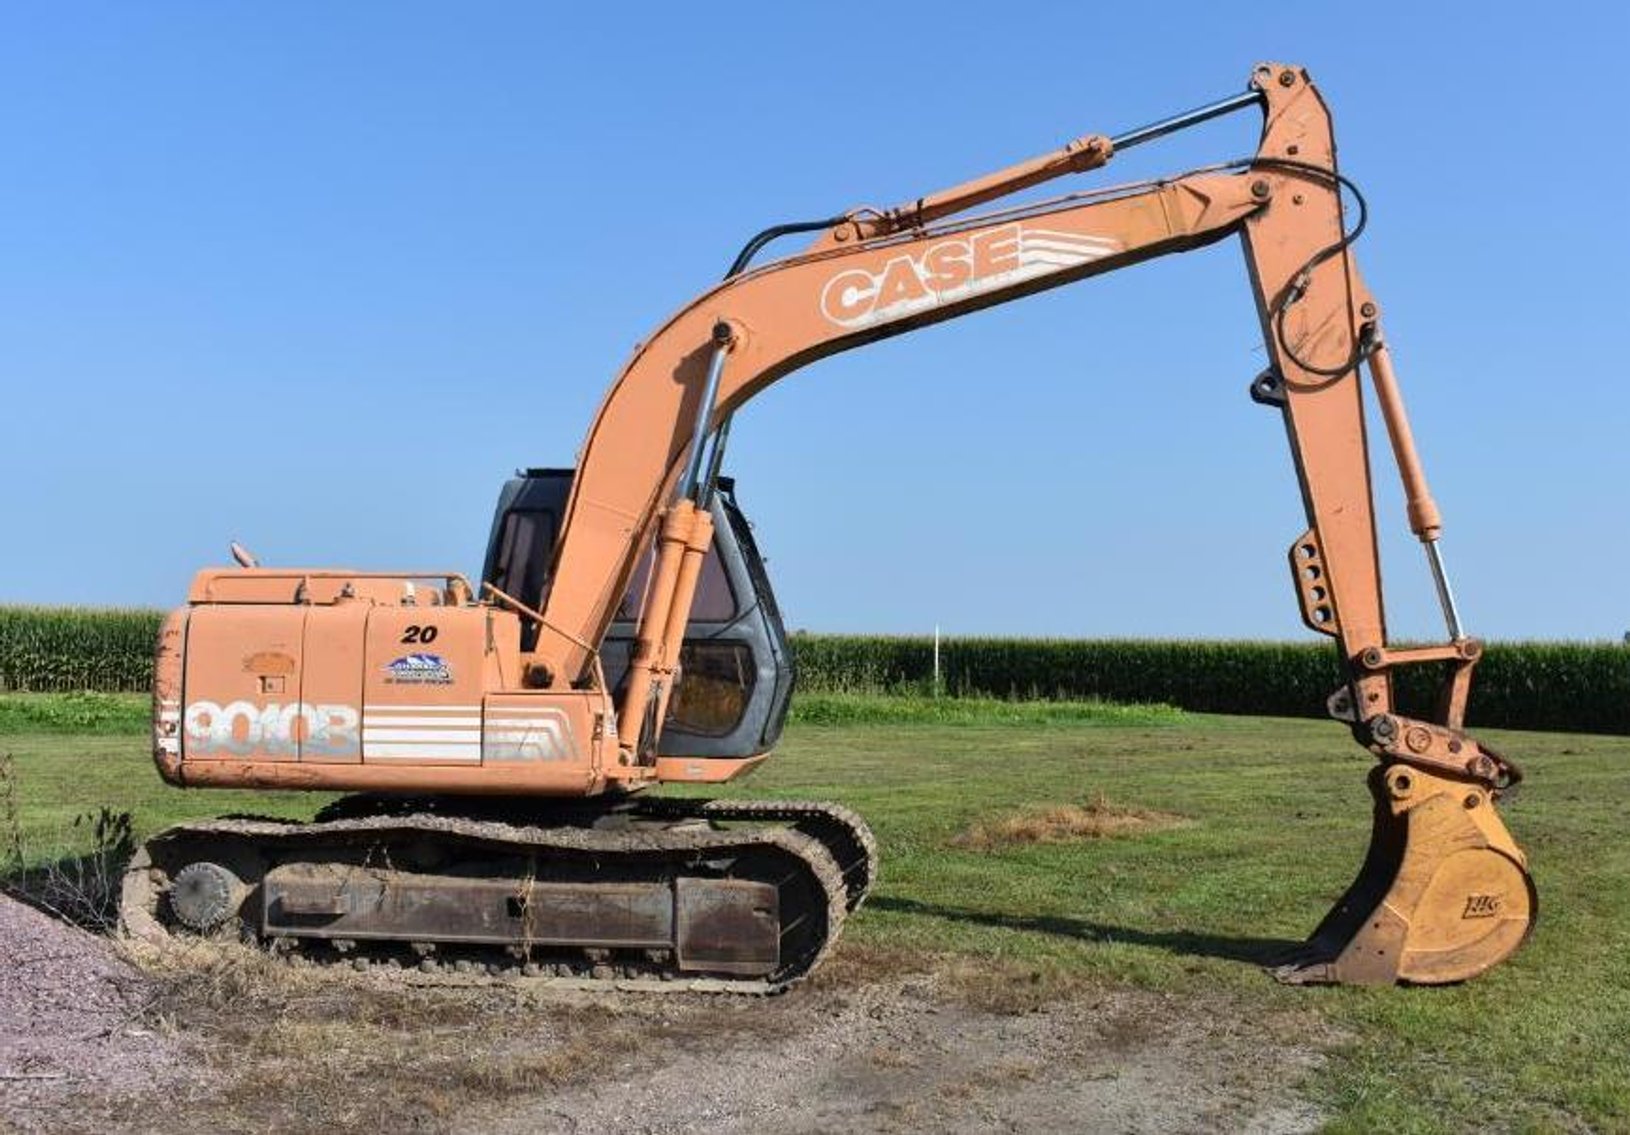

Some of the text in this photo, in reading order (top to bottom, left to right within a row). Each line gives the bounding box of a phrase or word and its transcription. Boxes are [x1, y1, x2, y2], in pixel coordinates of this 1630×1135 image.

[821, 224, 1022, 328] CASE
[400, 625, 438, 644] 20
[185, 701, 360, 755] 9010B
